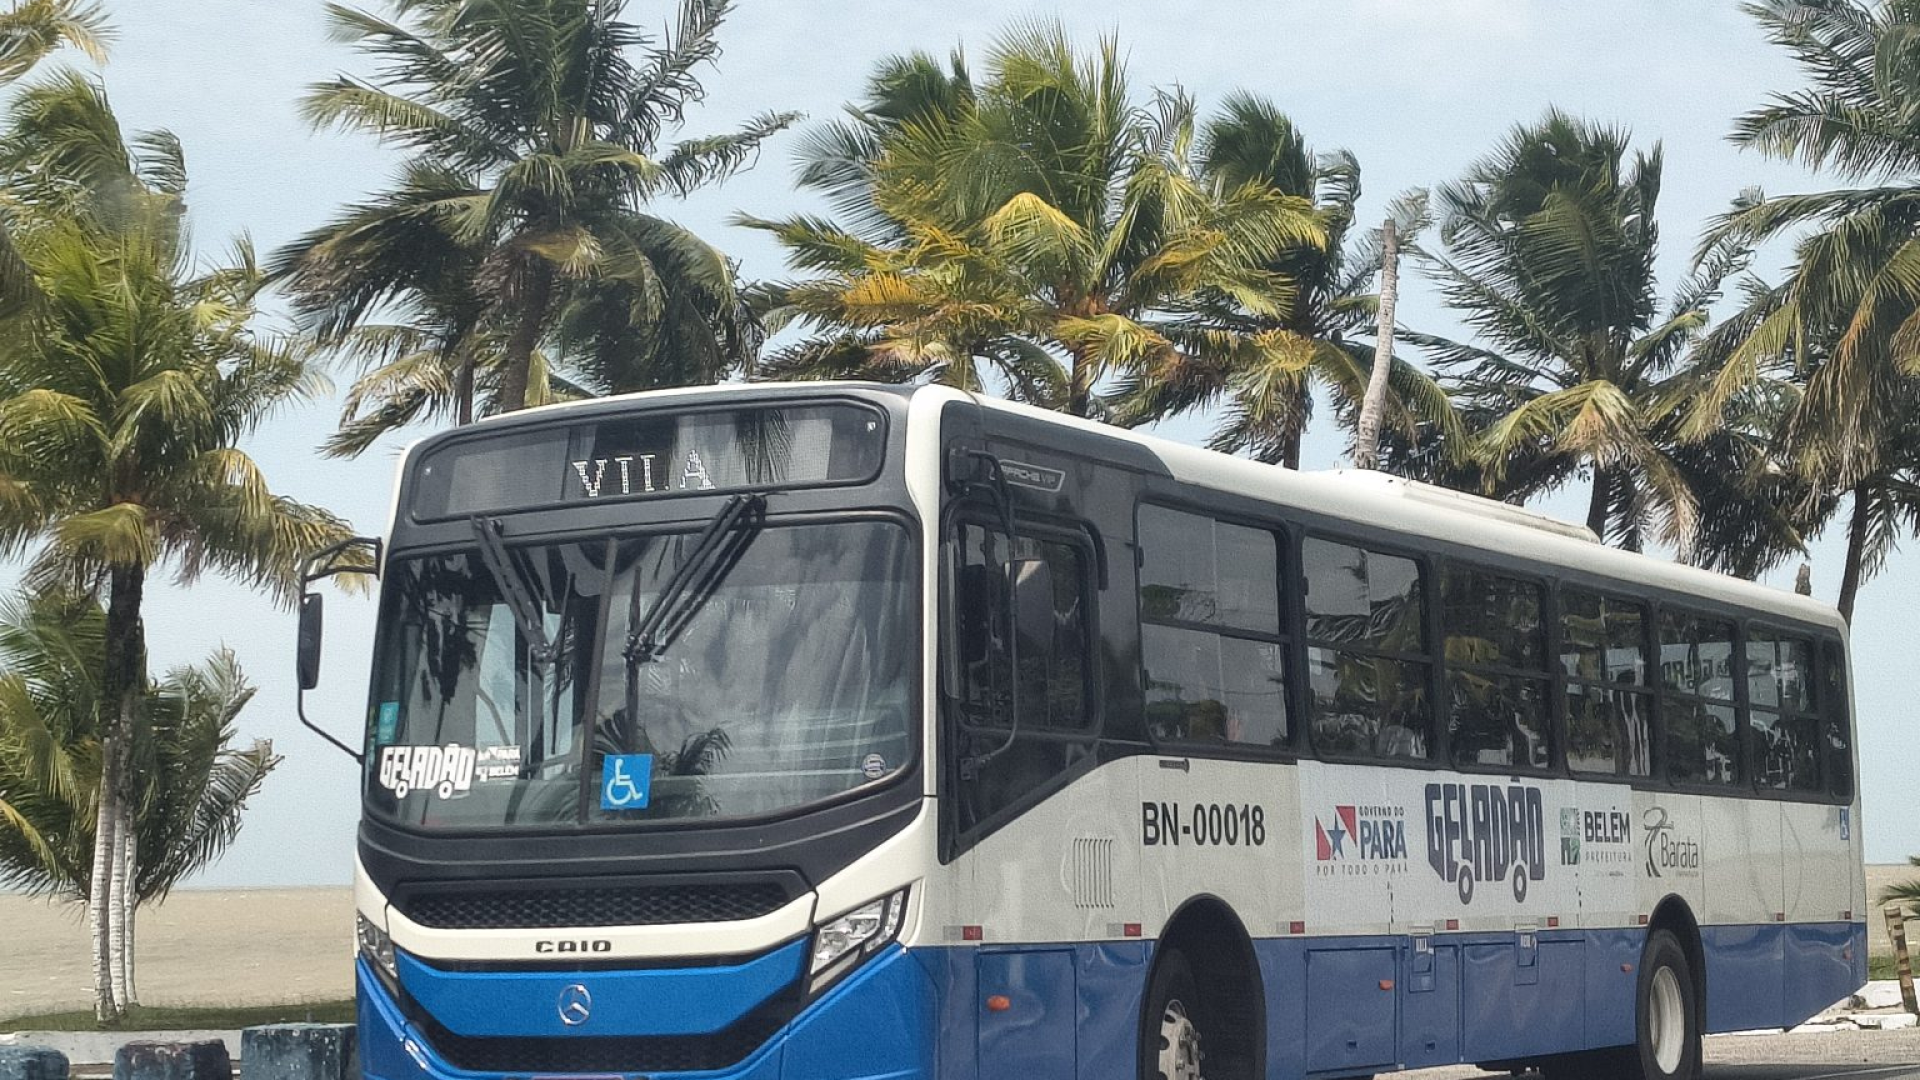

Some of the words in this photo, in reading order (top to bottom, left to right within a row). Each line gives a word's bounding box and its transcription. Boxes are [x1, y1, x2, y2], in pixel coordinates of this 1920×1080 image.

[380, 743, 476, 798] GELADÃO
[1142, 802, 1265, 846] BN-00018
[1394, 805, 1405, 817] DO
[1424, 775, 1545, 884] GELADÃO
[1584, 805, 1631, 844] BELÉM
[1660, 832, 1699, 869] Barata
[535, 940, 611, 953] CAIO
